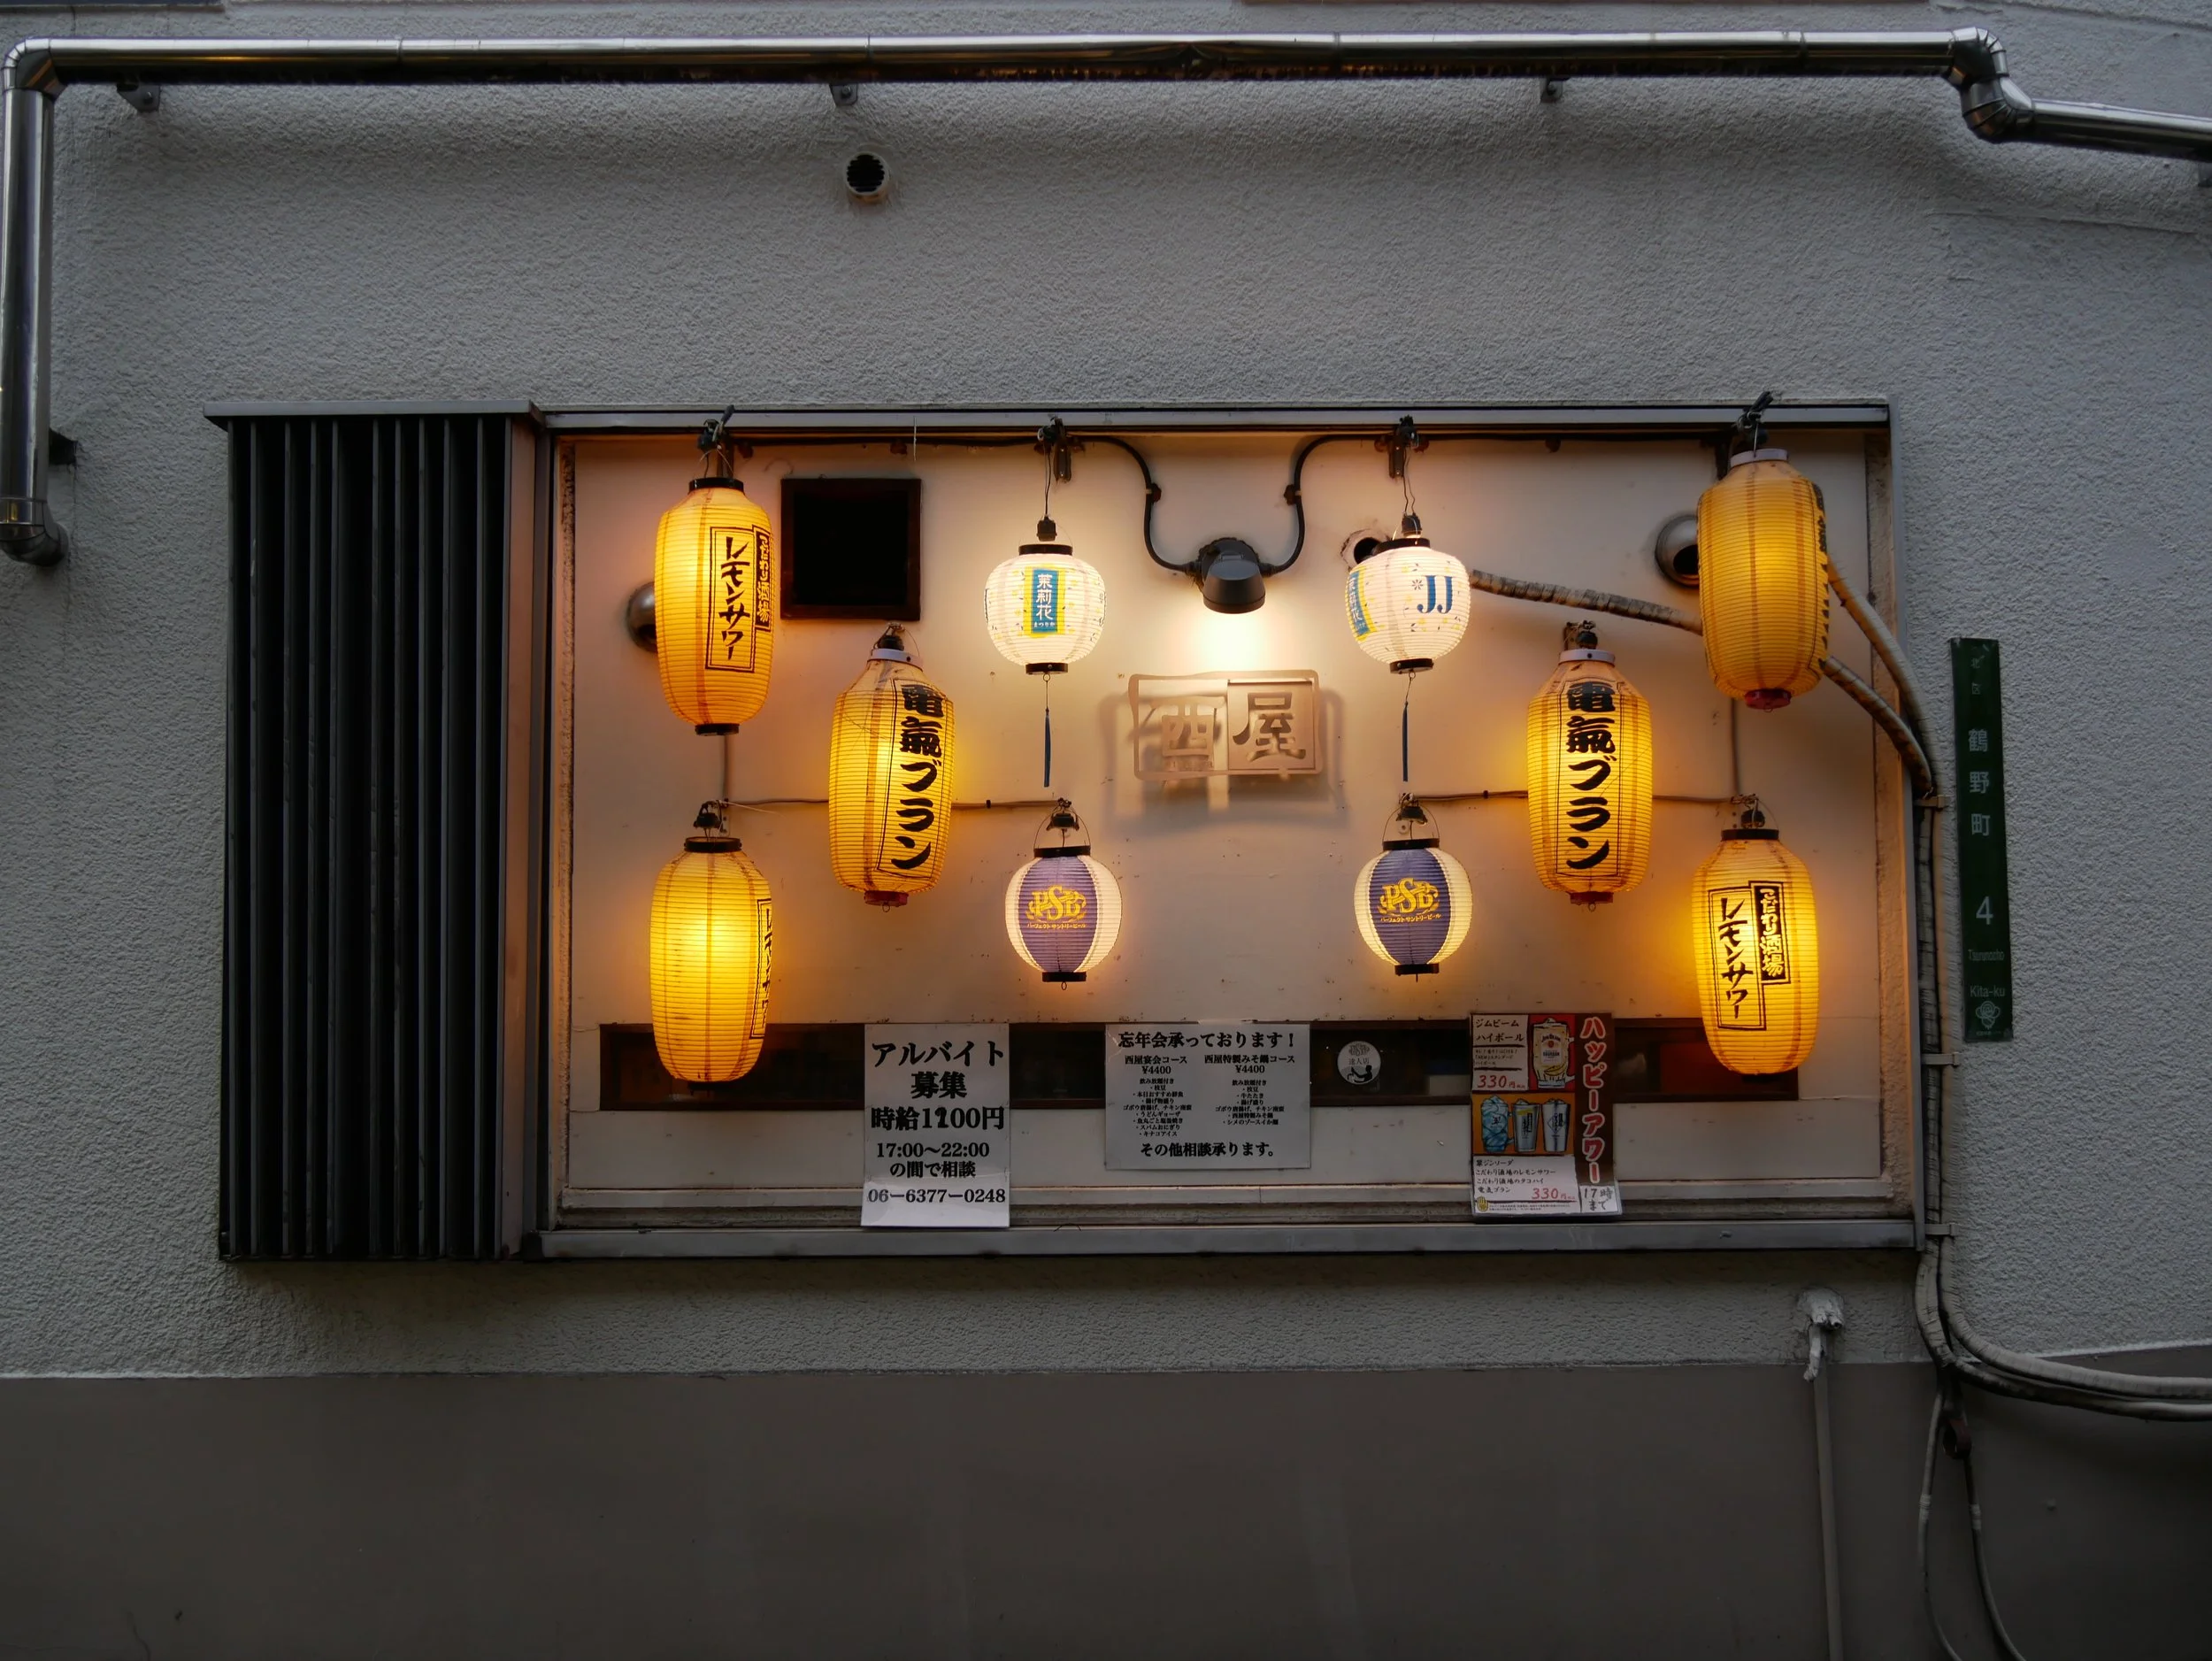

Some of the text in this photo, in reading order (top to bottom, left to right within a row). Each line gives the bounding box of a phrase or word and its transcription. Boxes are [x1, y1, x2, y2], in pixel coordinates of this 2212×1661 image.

[718, 536, 750, 661] レモンサワー
[1417, 574, 1454, 614] JJ
[1968, 728, 1993, 926] 鶴野町 4
[1760, 888, 1785, 977] こだわり酒場
[1718, 897, 1754, 1019] レモンサワー
[1970, 985, 2006, 997] Kita-ku
[1476, 1019, 1519, 1028] ジムビーム
[1476, 1033, 1525, 1042] ハイボール
[872, 1041, 1004, 1067] アルバイト
[1125, 1055, 1187, 1065] 西屋宴会コース
[1204, 1054, 1295, 1064] 西屋特製みそ鍋コース
[1141, 1065, 1171, 1074] ¥4400
[1235, 1065, 1265, 1073] ¥4400
[910, 1071, 967, 1099] 募集
[1580, 1016, 1607, 1184] ハッピーアワー
[1141, 1142, 1274, 1157] その他相談承ります。
[889, 1161, 976, 1178] の間で相談
[1584, 1187, 1613, 1199] 17時
[1588, 1199, 1609, 1211] まで
